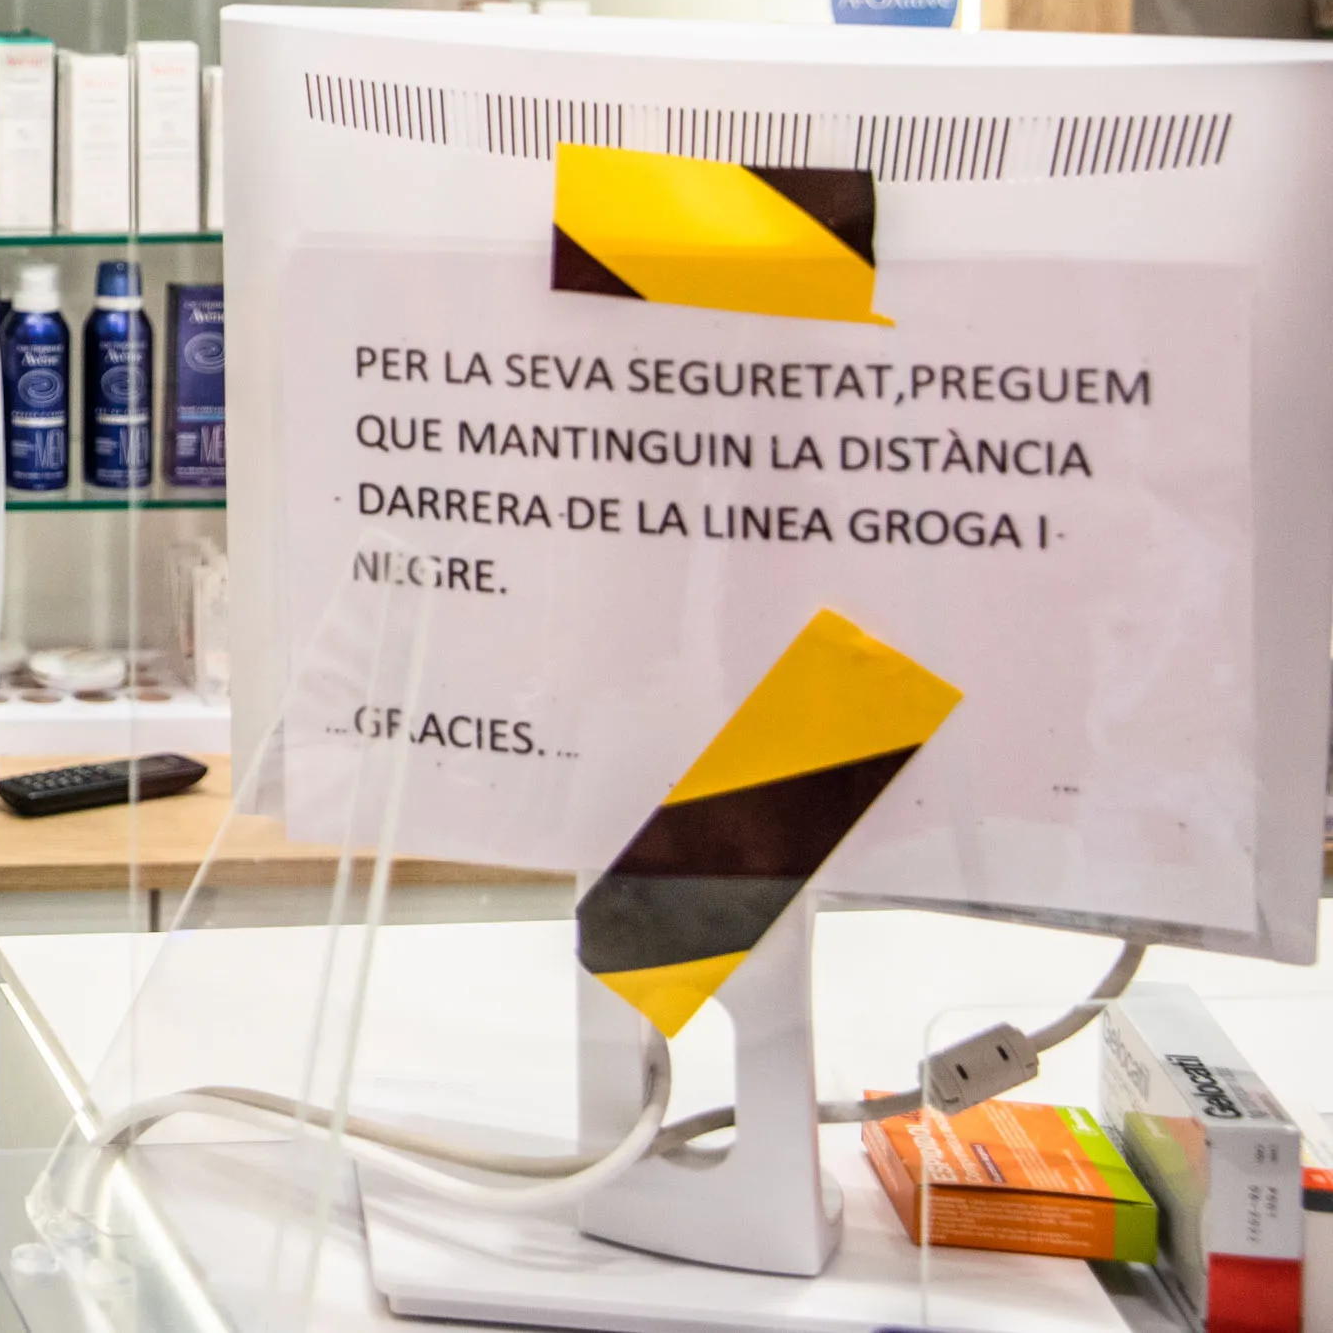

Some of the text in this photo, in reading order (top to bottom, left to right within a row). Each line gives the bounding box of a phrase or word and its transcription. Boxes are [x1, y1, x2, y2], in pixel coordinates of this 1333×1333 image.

[355, 345, 1152, 407] PER LA SEVA SEGURETAT,PREGUEM
[355, 413, 1094, 479] QUE MANTINGUIN LA DISTÀNCIA
[358, 481, 1050, 551] DARRERA DE LA LINEA GROGA I
[1163, 1052, 1243, 1120] Gelocatil
